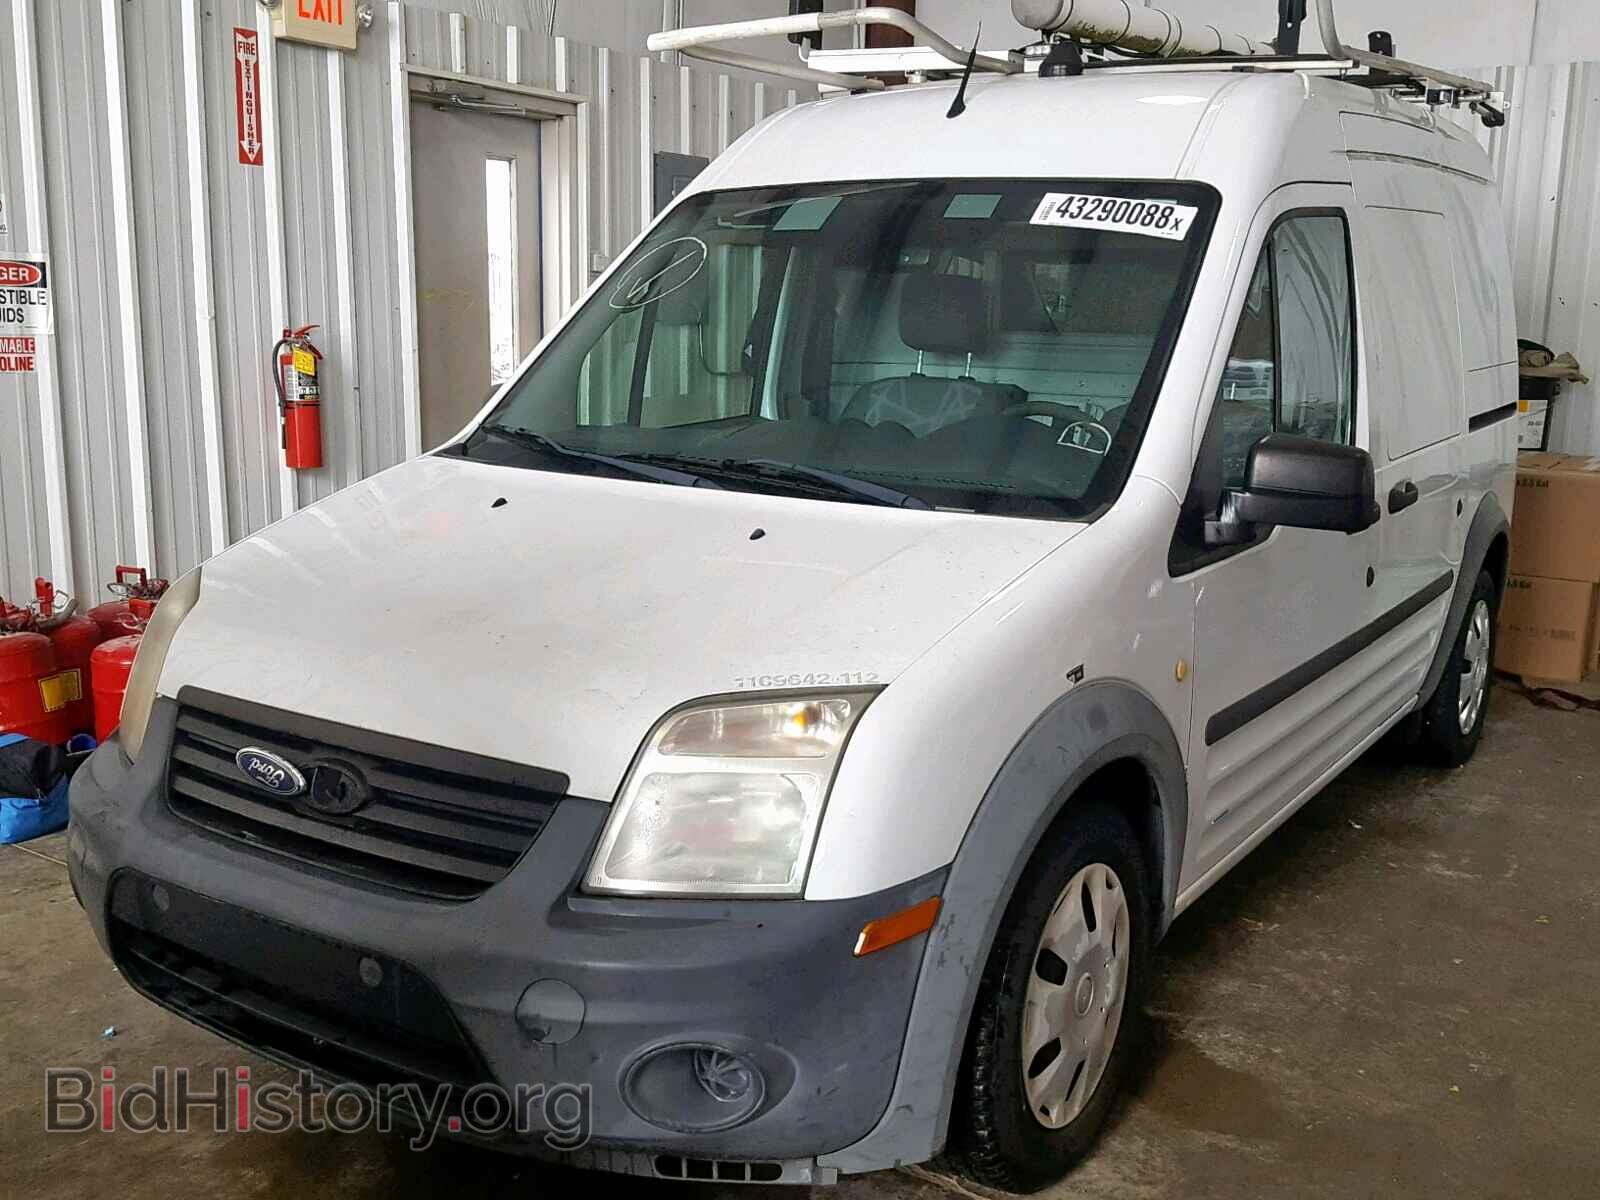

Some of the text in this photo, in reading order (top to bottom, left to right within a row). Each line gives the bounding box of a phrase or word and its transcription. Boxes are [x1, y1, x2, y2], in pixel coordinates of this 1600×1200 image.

[237, 41, 256, 56] FIRE
[245, 59, 255, 155] EXTINGUISHER
[248, 757, 285, 789] Ford
